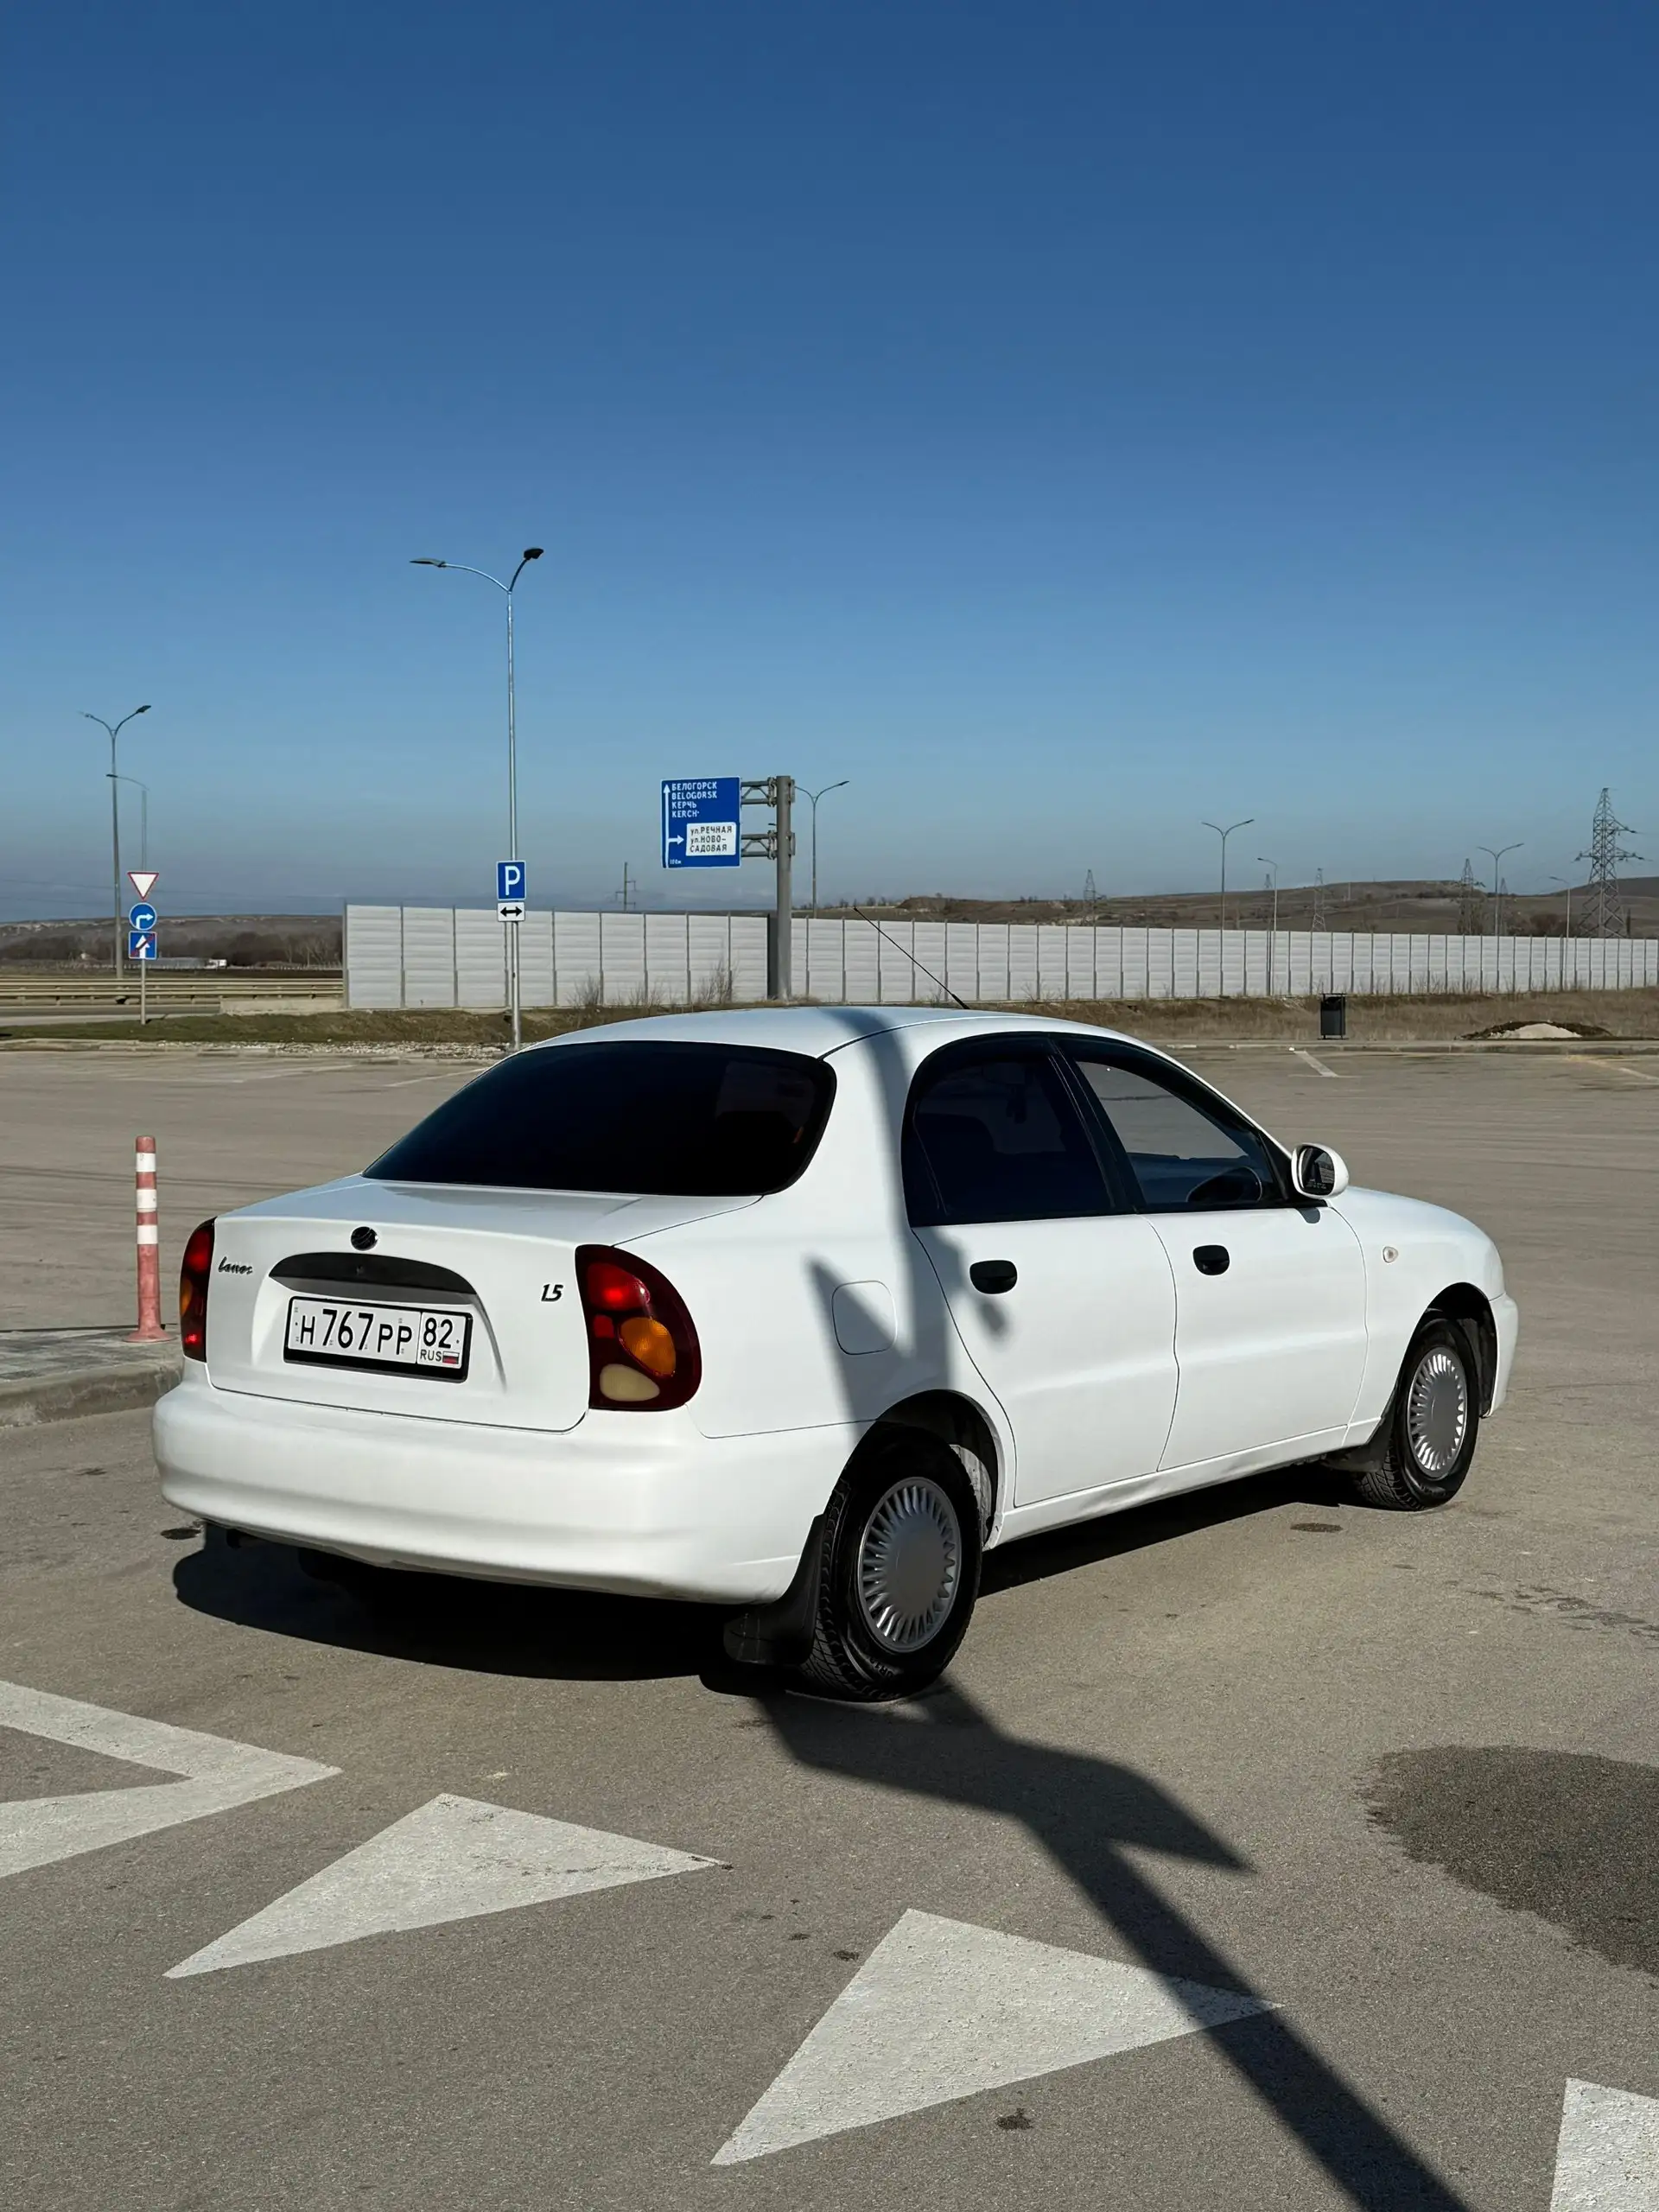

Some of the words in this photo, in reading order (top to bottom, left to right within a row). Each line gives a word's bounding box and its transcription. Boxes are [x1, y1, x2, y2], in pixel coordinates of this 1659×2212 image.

[671, 781, 717, 791] БЕЛОГОРСК
[671, 791, 717, 800] BELOGORSK
[671, 801, 697, 810] КЕРЧЬ
[690, 844, 728, 853] САДОВАЯ
[505, 865, 521, 896] P
[423, 1317, 454, 1349] 82
[420, 1349, 442, 1363] RUS
